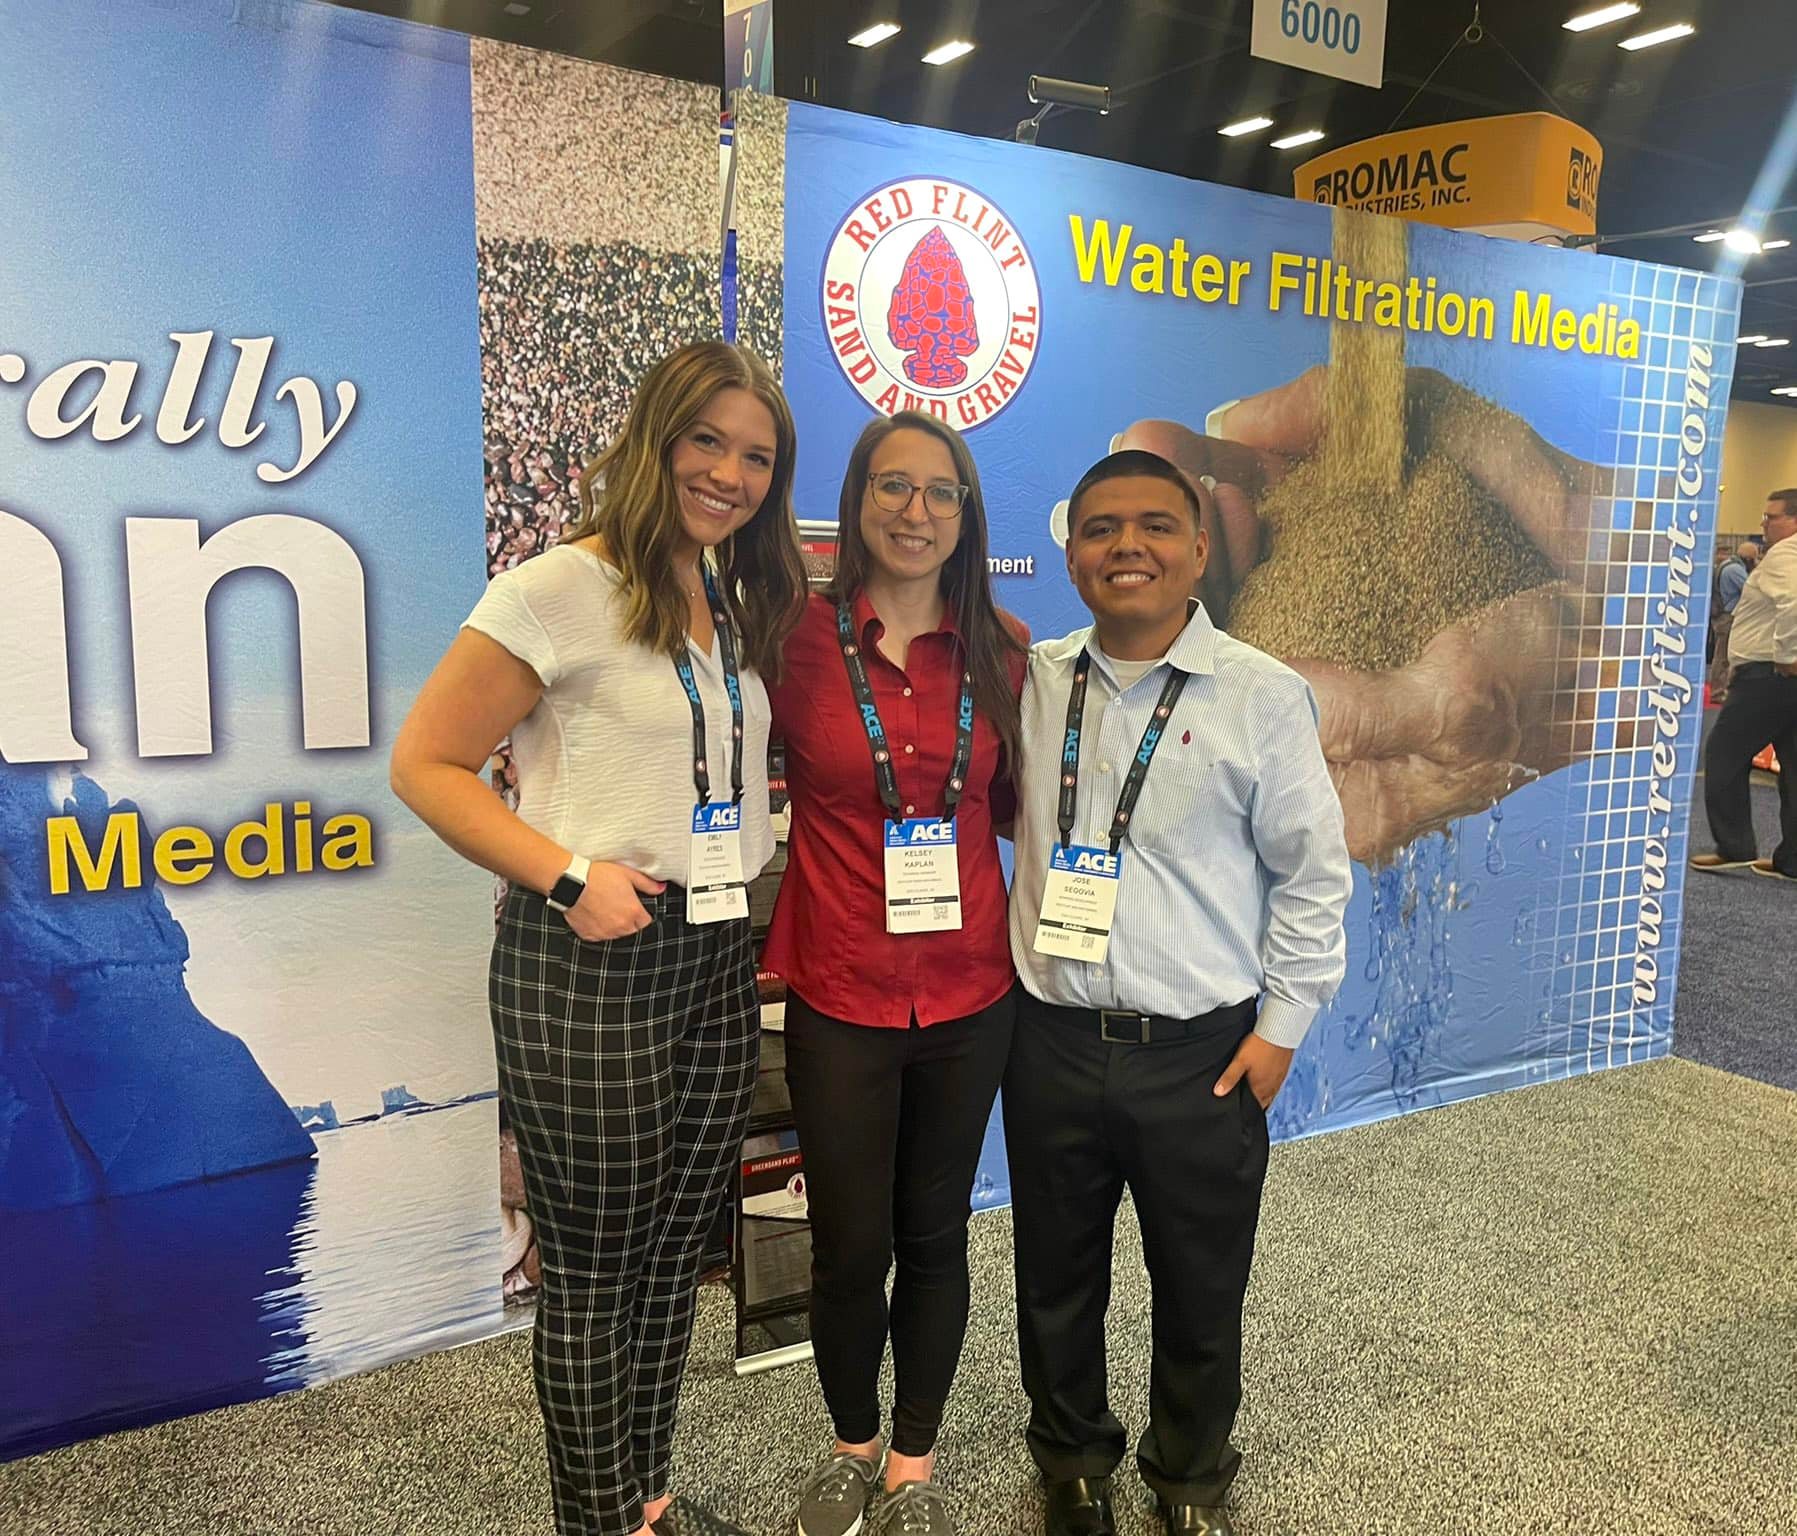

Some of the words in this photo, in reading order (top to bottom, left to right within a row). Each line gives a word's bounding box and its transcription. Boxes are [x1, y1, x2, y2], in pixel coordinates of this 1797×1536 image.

[1281, 0, 1361, 54] 6000
[1332, 144, 1468, 205] ROMAC
[1432, 186, 1471, 206] INC.
[844, 187, 914, 252] RED
[932, 185, 1026, 271] FLINT
[1069, 214, 1250, 305] Water
[1269, 251, 1494, 340] Filtration
[1511, 290, 1641, 360] Media
[826, 280, 878, 384] SAND
[957, 306, 1037, 426] GRAVEL
[725, 672, 741, 712] ACE
[1632, 343, 1713, 1006] www.redflint.com
[860, 703, 883, 739] ACE
[959, 695, 973, 733] ACE
[1063, 728, 1079, 763] ACE
[1136, 728, 1160, 766] ACE
[709, 807, 739, 826] ACE
[910, 822, 953, 841] ACE
[46, 801, 375, 895] Media
[904, 849, 933, 857] KELSEY
[904, 860, 935, 868] KAPLAN
[1073, 852, 1118, 873] ACE
[1064, 886, 1097, 896] SEGOVIA
[1072, 876, 1091, 885] JOSE
